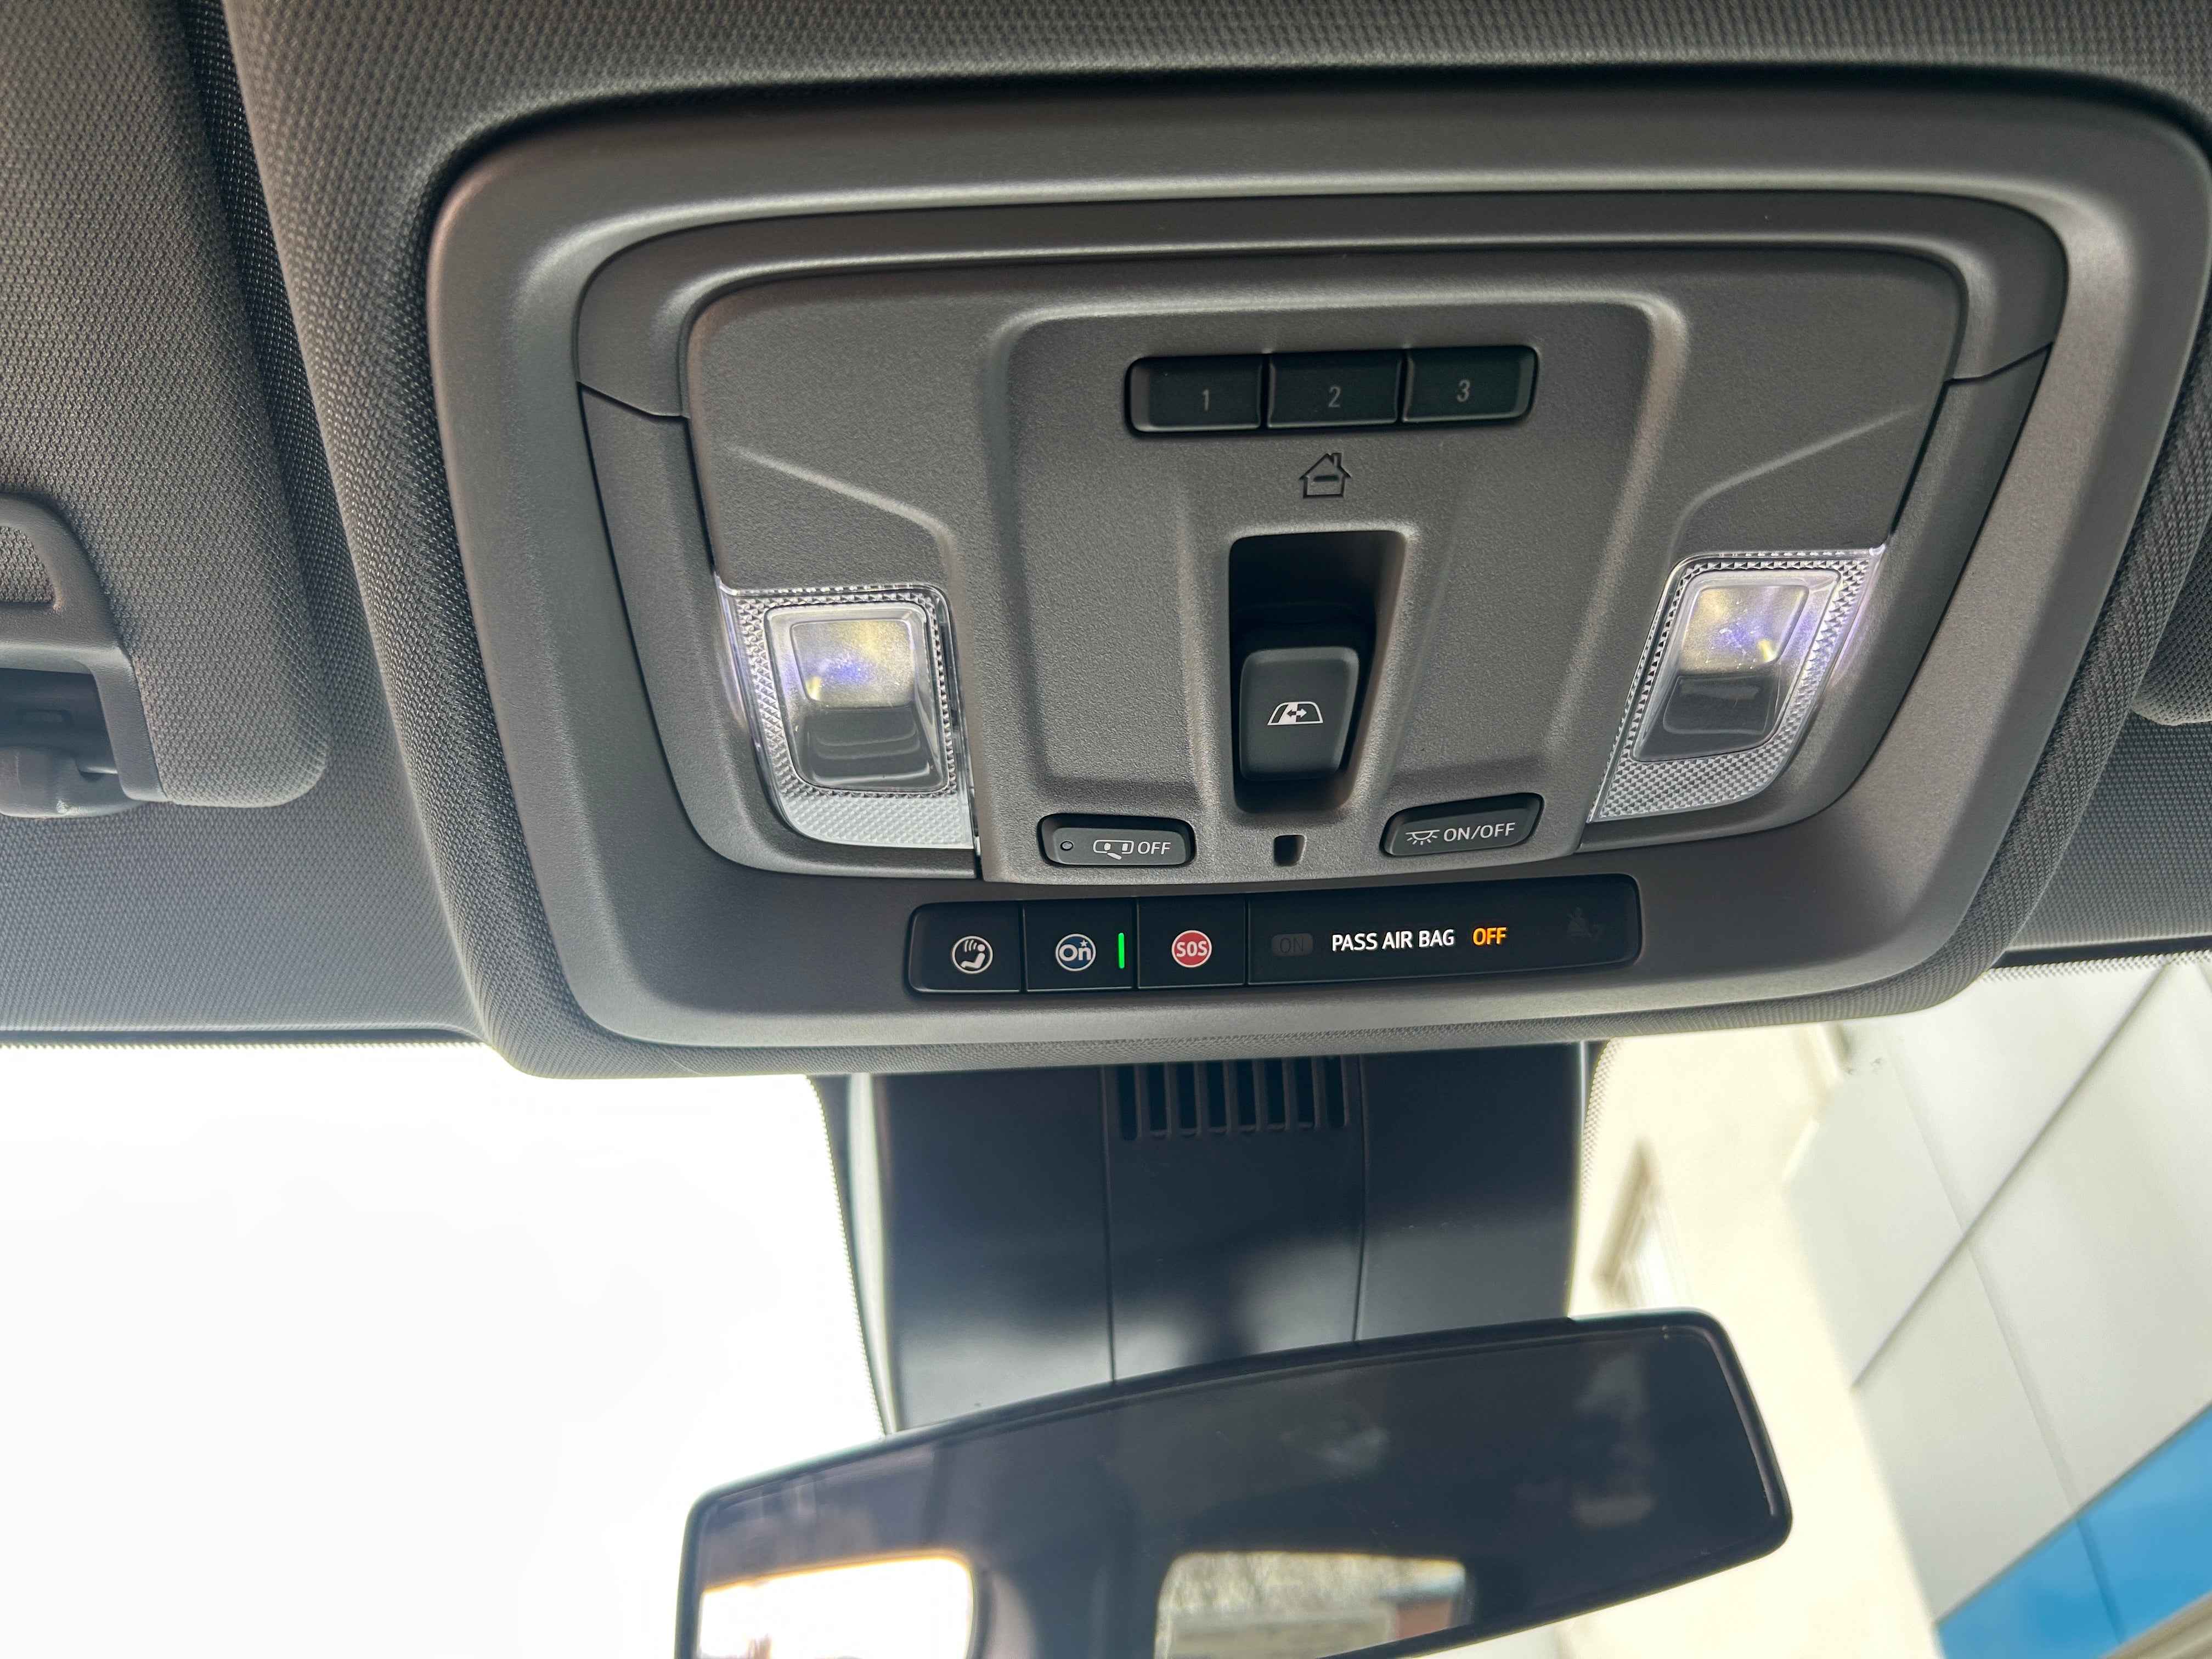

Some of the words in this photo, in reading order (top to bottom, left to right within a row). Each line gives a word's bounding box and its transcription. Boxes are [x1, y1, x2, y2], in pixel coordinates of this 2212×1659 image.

[1201, 388, 1209, 411] 1
[1328, 386, 1342, 408] 2
[1456, 379, 1471, 402] 3
[1443, 822, 1515, 842] ON/OFF
[1137, 841, 1171, 855] OFF
[1176, 940, 1209, 957] SOS
[1279, 936, 1305, 954] ON
[1332, 933, 1377, 951] PASS
[1382, 931, 1413, 950] AIR
[1419, 929, 1455, 949] BAG
[1472, 927, 1508, 946] OFF
[1059, 944, 1092, 961] On
